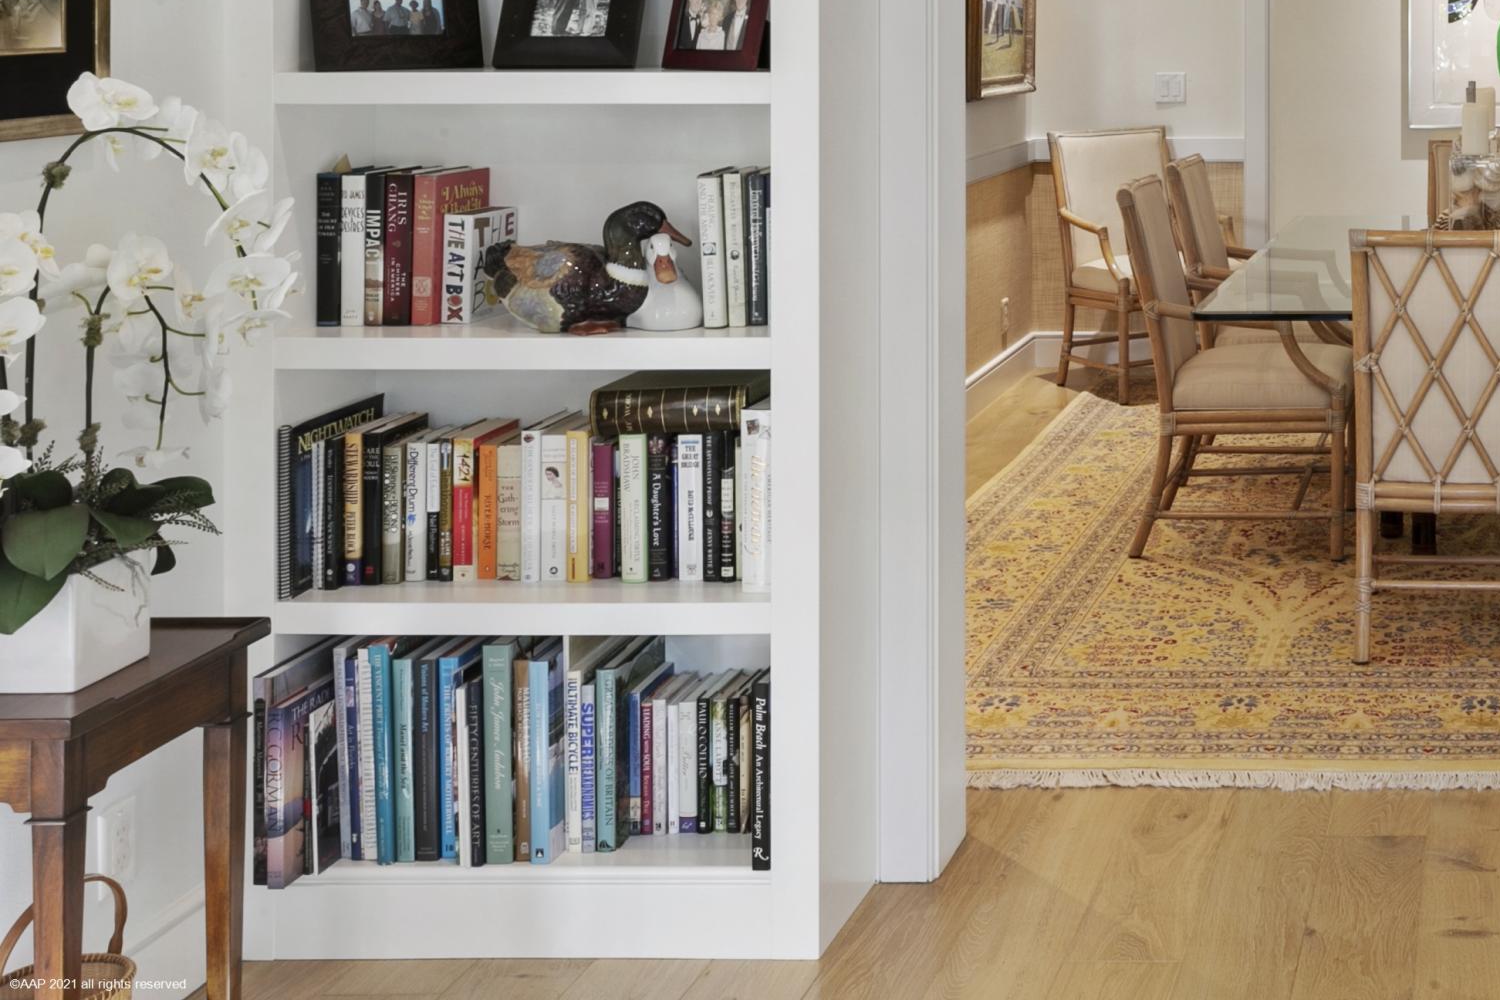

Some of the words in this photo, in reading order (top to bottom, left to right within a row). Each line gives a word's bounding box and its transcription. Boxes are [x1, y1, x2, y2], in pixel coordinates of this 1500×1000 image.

[387, 183, 397, 233] CHANG
[397, 191, 407, 225] IRIS
[447, 219, 465, 250] THE
[473, 211, 515, 249] THE
[447, 252, 466, 283] ART
[446, 285, 463, 322] BOX
[297, 407, 375, 455] NIGHTWATCH
[344, 443, 359, 505] STEWARDSHIP
[406, 451, 419, 488] Different
[456, 453, 471, 482] 1421
[622, 443, 631, 493] BRADSHAW
[632, 455, 640, 480] JOHN
[408, 488, 418, 513] Drum
[651, 482, 662, 526] Daughter's
[346, 511, 356, 531] PETER
[346, 533, 356, 554] BLOCK
[652, 528, 661, 547] Love
[421, 663, 429, 687] Visions
[490, 677, 504, 706] John
[567, 681, 578, 729] ULTIMATE
[421, 696, 429, 721] Modern
[469, 704, 478, 736] FIFTY
[490, 706, 504, 742] James
[643, 709, 651, 739] LEADING
[698, 702, 708, 734] PAULO
[756, 697, 766, 720] Palm
[399, 723, 407, 746] Manet
[421, 721, 429, 732] Art
[715, 721, 723, 746] ANNE
[755, 724, 766, 750] Beach
[399, 748, 407, 762] and
[493, 744, 505, 790] Audubon
[568, 732, 579, 772] BICYCLE
[698, 736, 708, 779] COELHO
[756, 754, 764, 767] An
[400, 764, 408, 775] the
[470, 738, 479, 801] CENTURIES
[605, 768, 613, 780] OF
[266, 744, 282, 833] GORMAN
[755, 769, 765, 813] Architectural
[445, 778, 453, 835] MOTHERWELL
[471, 804, 479, 820] OF
[605, 785, 613, 826] BRITAIN
[471, 823, 481, 848] ART
[754, 815, 764, 839] Legacy
